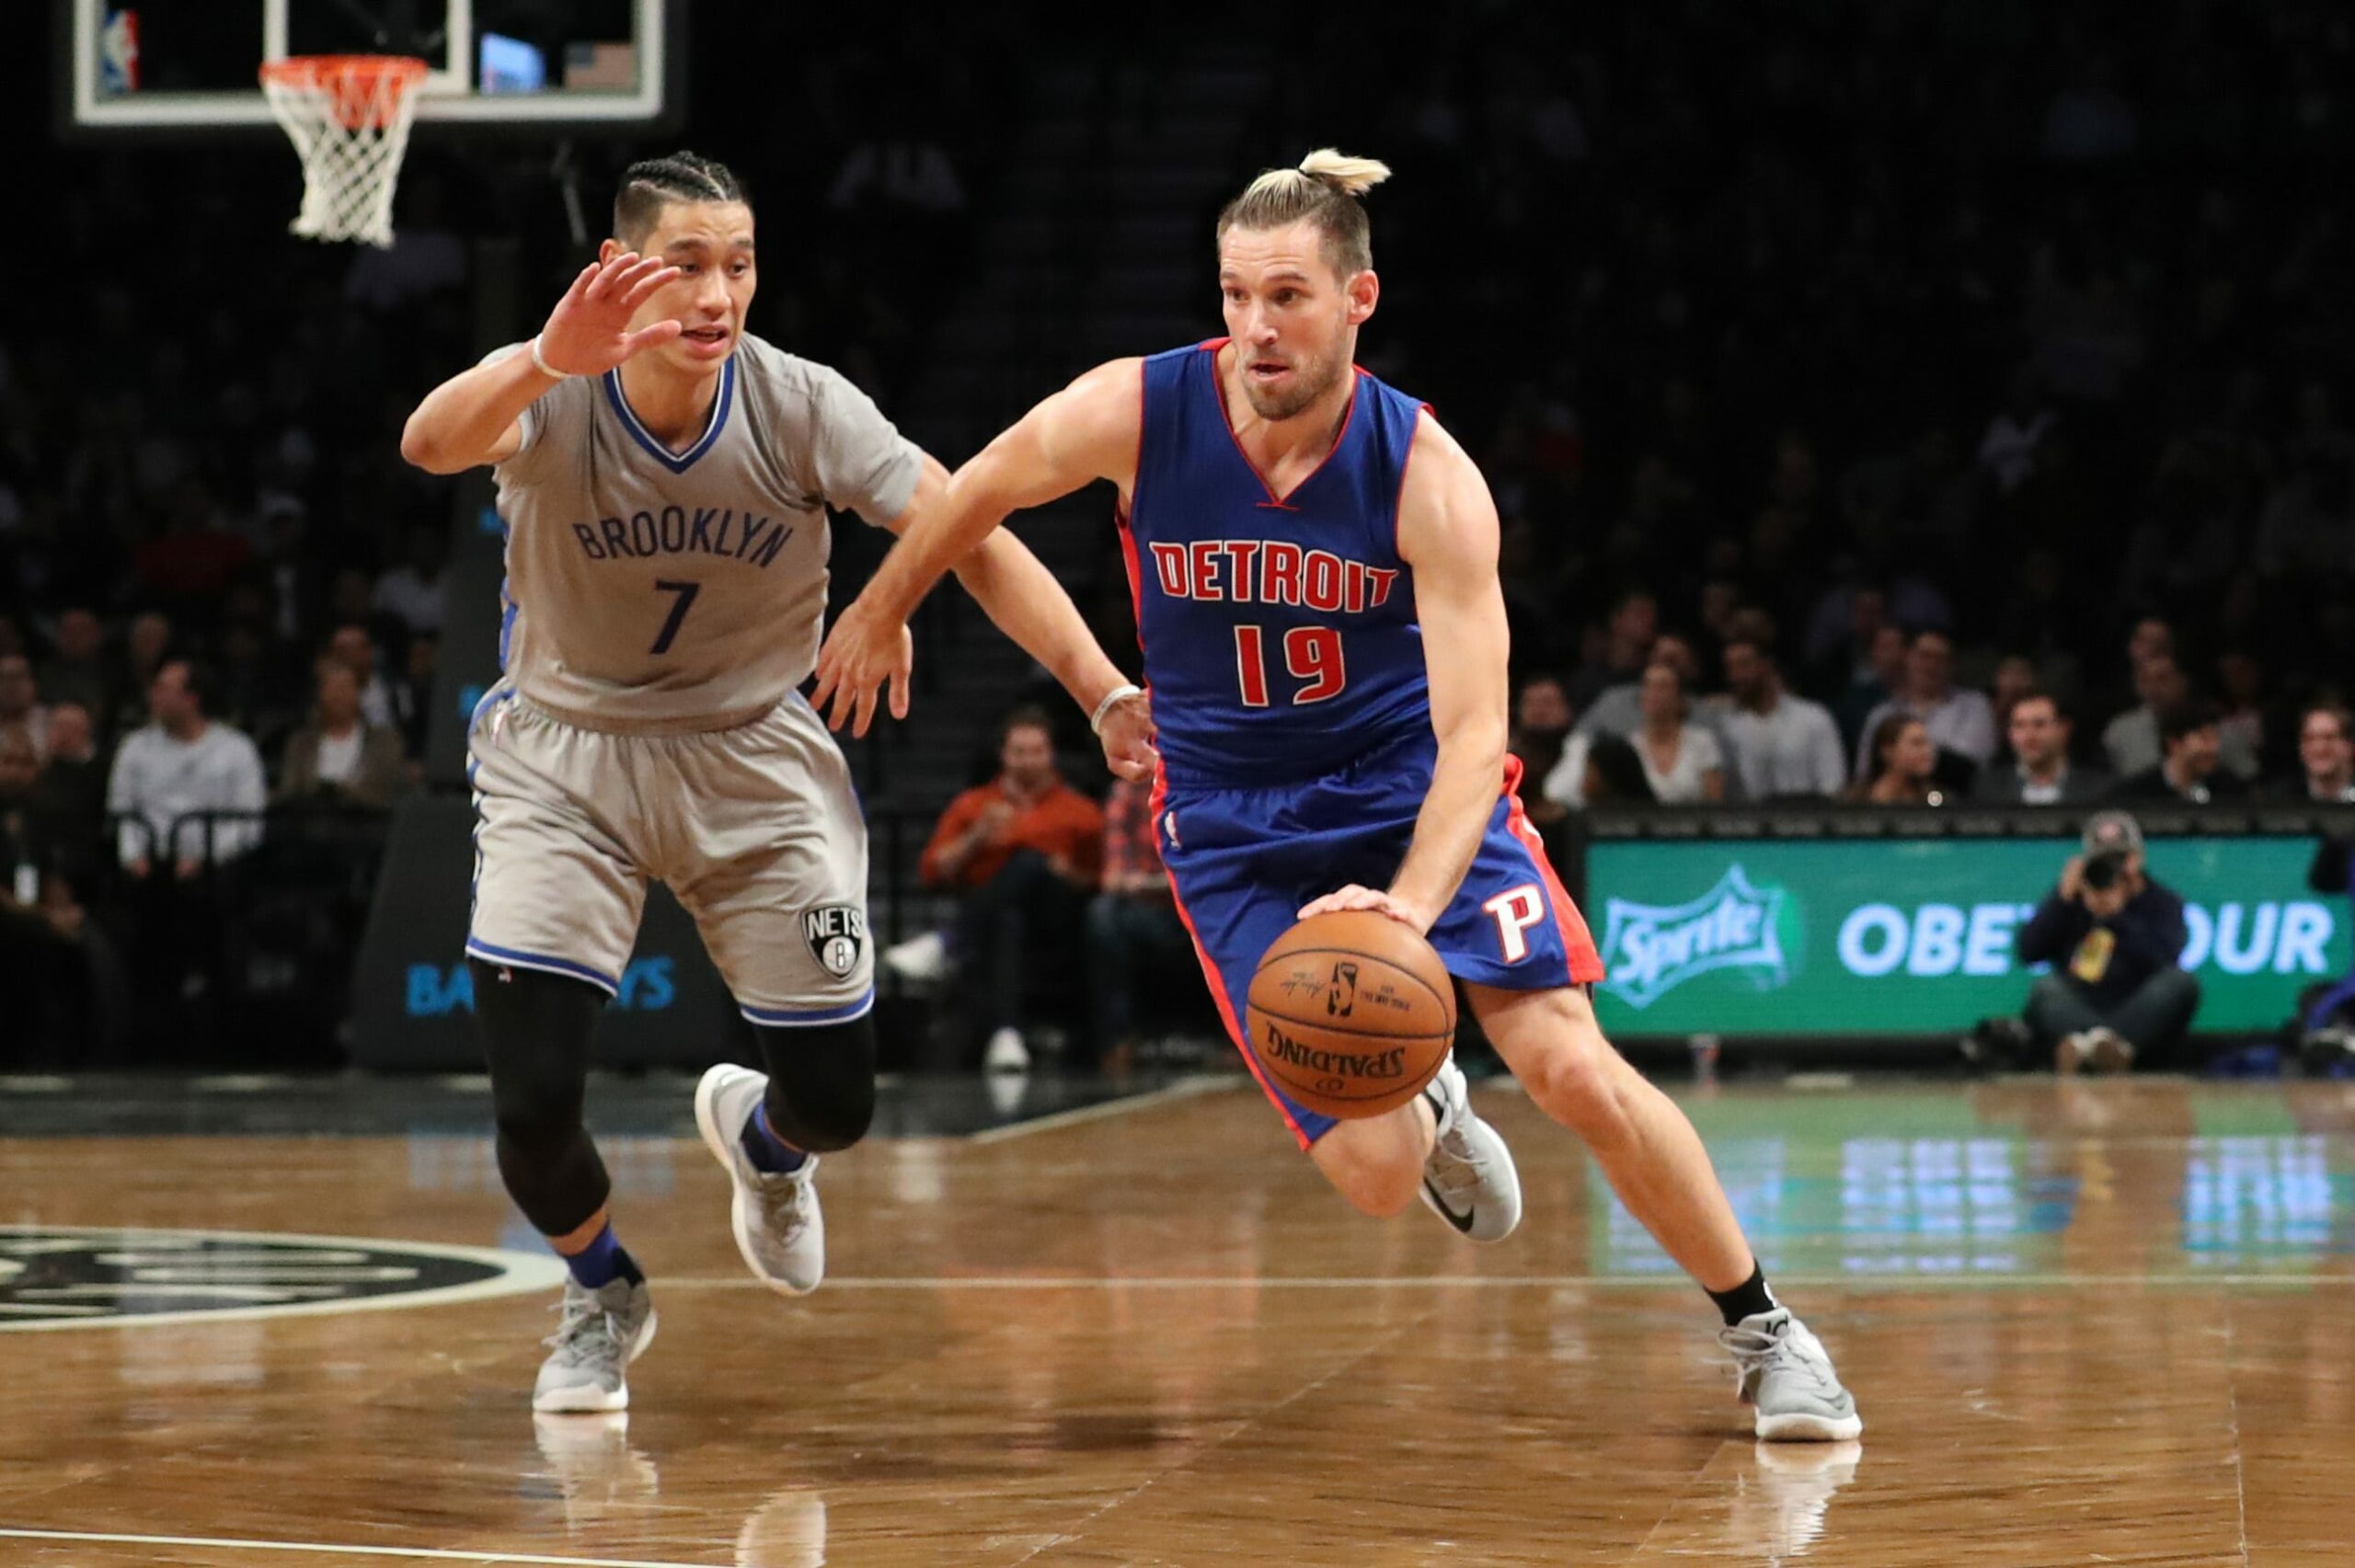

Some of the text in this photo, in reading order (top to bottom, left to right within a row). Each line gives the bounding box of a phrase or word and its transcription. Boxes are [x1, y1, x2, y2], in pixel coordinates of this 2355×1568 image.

[572, 505, 794, 569] BROOKLYN
[1149, 540, 1399, 613] DETROIT
[649, 579, 700, 655] 7
[1234, 624, 1346, 707] 19
[808, 907, 862, 941] NETS
[1480, 883, 1546, 964] P
[1612, 894, 1763, 984] Sprite
[1836, 902, 2055, 977] OBE
[1267, 1021, 1406, 1079] SPALDING
